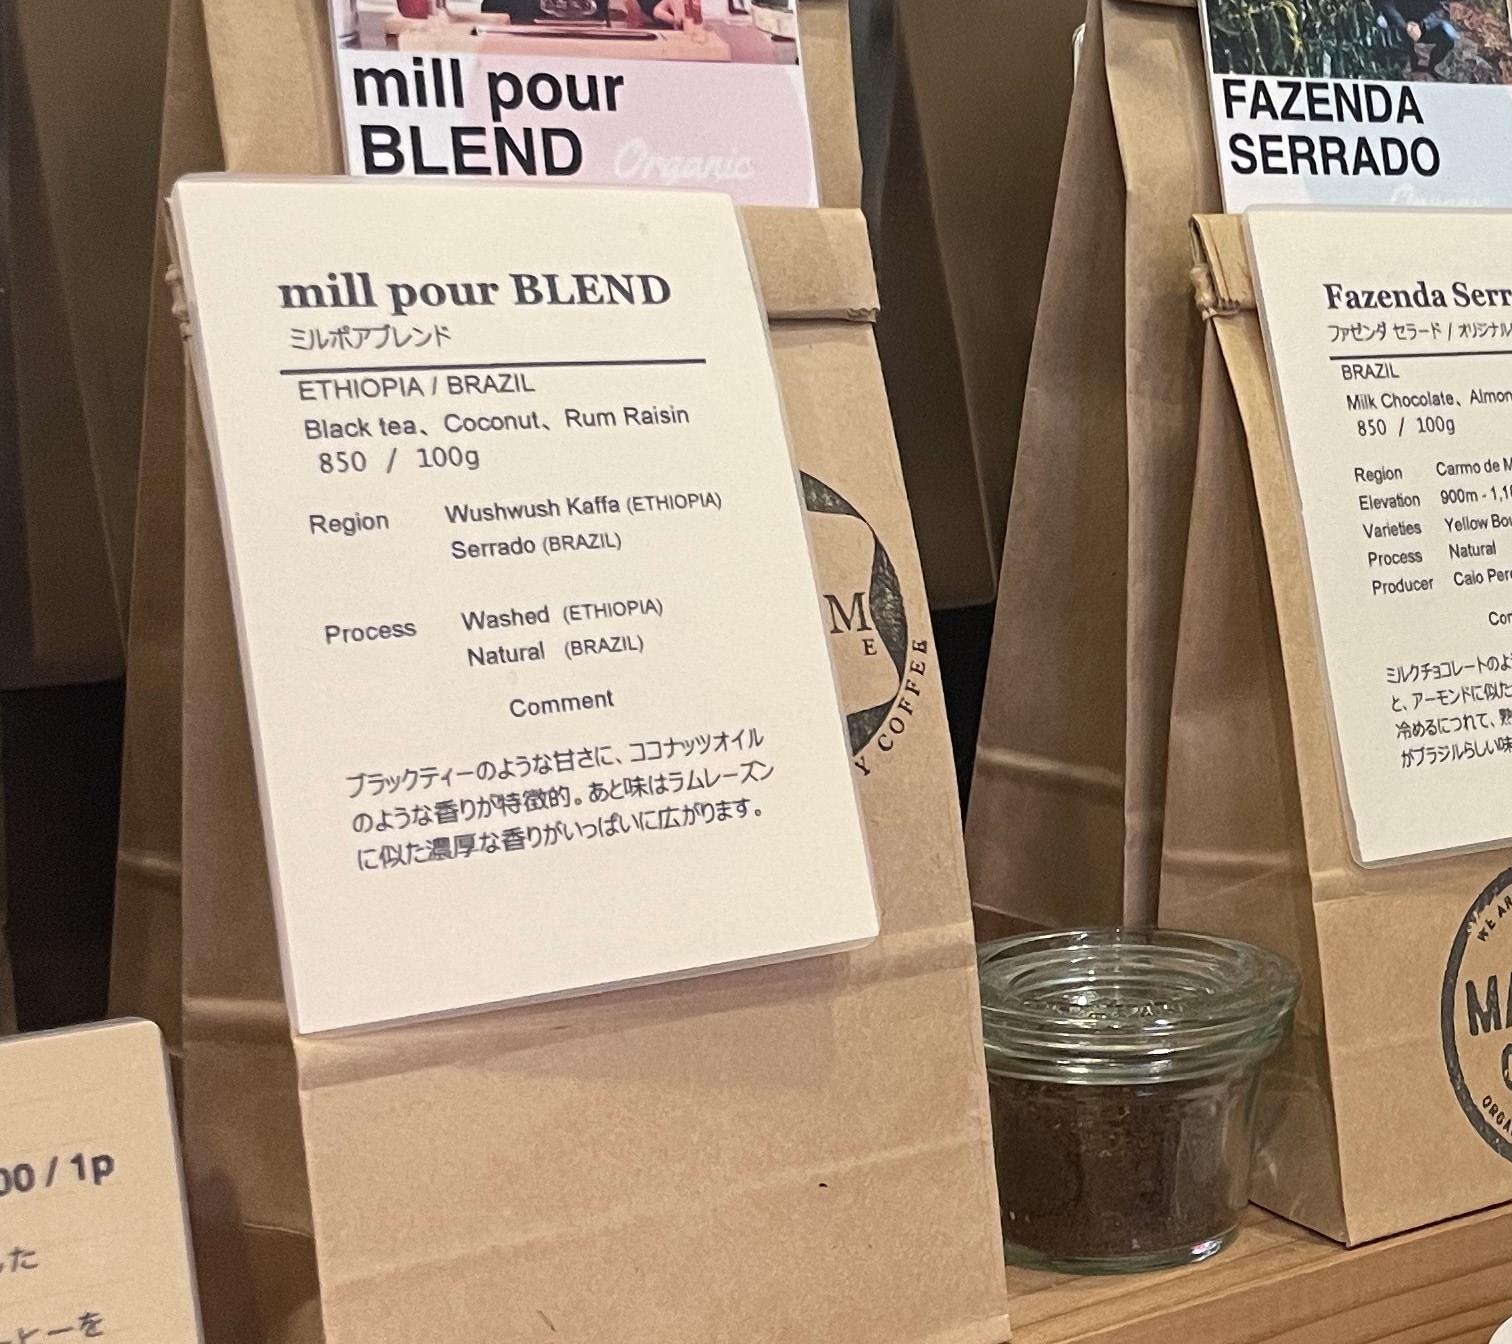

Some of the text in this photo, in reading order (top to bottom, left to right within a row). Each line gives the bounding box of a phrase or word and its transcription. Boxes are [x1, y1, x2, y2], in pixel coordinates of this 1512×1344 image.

[353, 57, 625, 123] mill pour
[1222, 79, 1424, 124] FAZENDA
[360, 124, 583, 178] BLEND
[613, 136, 756, 184] Organic
[1228, 133, 1441, 178] SERRADO
[278, 272, 672, 316] mill pour BLEND
[1323, 281, 1448, 310] Fazenda
[289, 324, 452, 351] ミルポアブレンド
[1392, 322, 1442, 340] セラード
[1341, 362, 1400, 381] BRAZIL
[298, 373, 536, 401] ETHIOPIA / BRAZIL
[1346, 393, 1378, 411] Milk
[304, 419, 372, 440] Black
[565, 408, 617, 429] Rum
[624, 406, 690, 427] Raisin
[1357, 415, 1456, 437] 850 / 100g
[319, 445, 480, 475] 850 / 100g
[1354, 466, 1403, 485] Region
[1436, 460, 1481, 477] Carmo
[1484, 458, 1500, 474] de
[309, 492, 722, 536] Region Wushwush Kaffa (ETHIOPIA)
[1359, 493, 1421, 511] Elevation
[1440, 488, 1479, 506] 900m
[1362, 520, 1422, 539] Varieties
[1444, 515, 1489, 533] Yellow
[451, 531, 622, 560] Serrado (BRAZIL)
[1368, 539, 1497, 567] Process Natural
[1372, 577, 1434, 596] Producer
[1453, 570, 1484, 587] Caio
[325, 598, 664, 644] Process Washed (ETHIOPIA)
[467, 635, 645, 668] Natural (BRAZIL)
[509, 689, 615, 718] Comment
[46, 1156, 59, 1188] /
[70, 1152, 116, 1186] 1p
